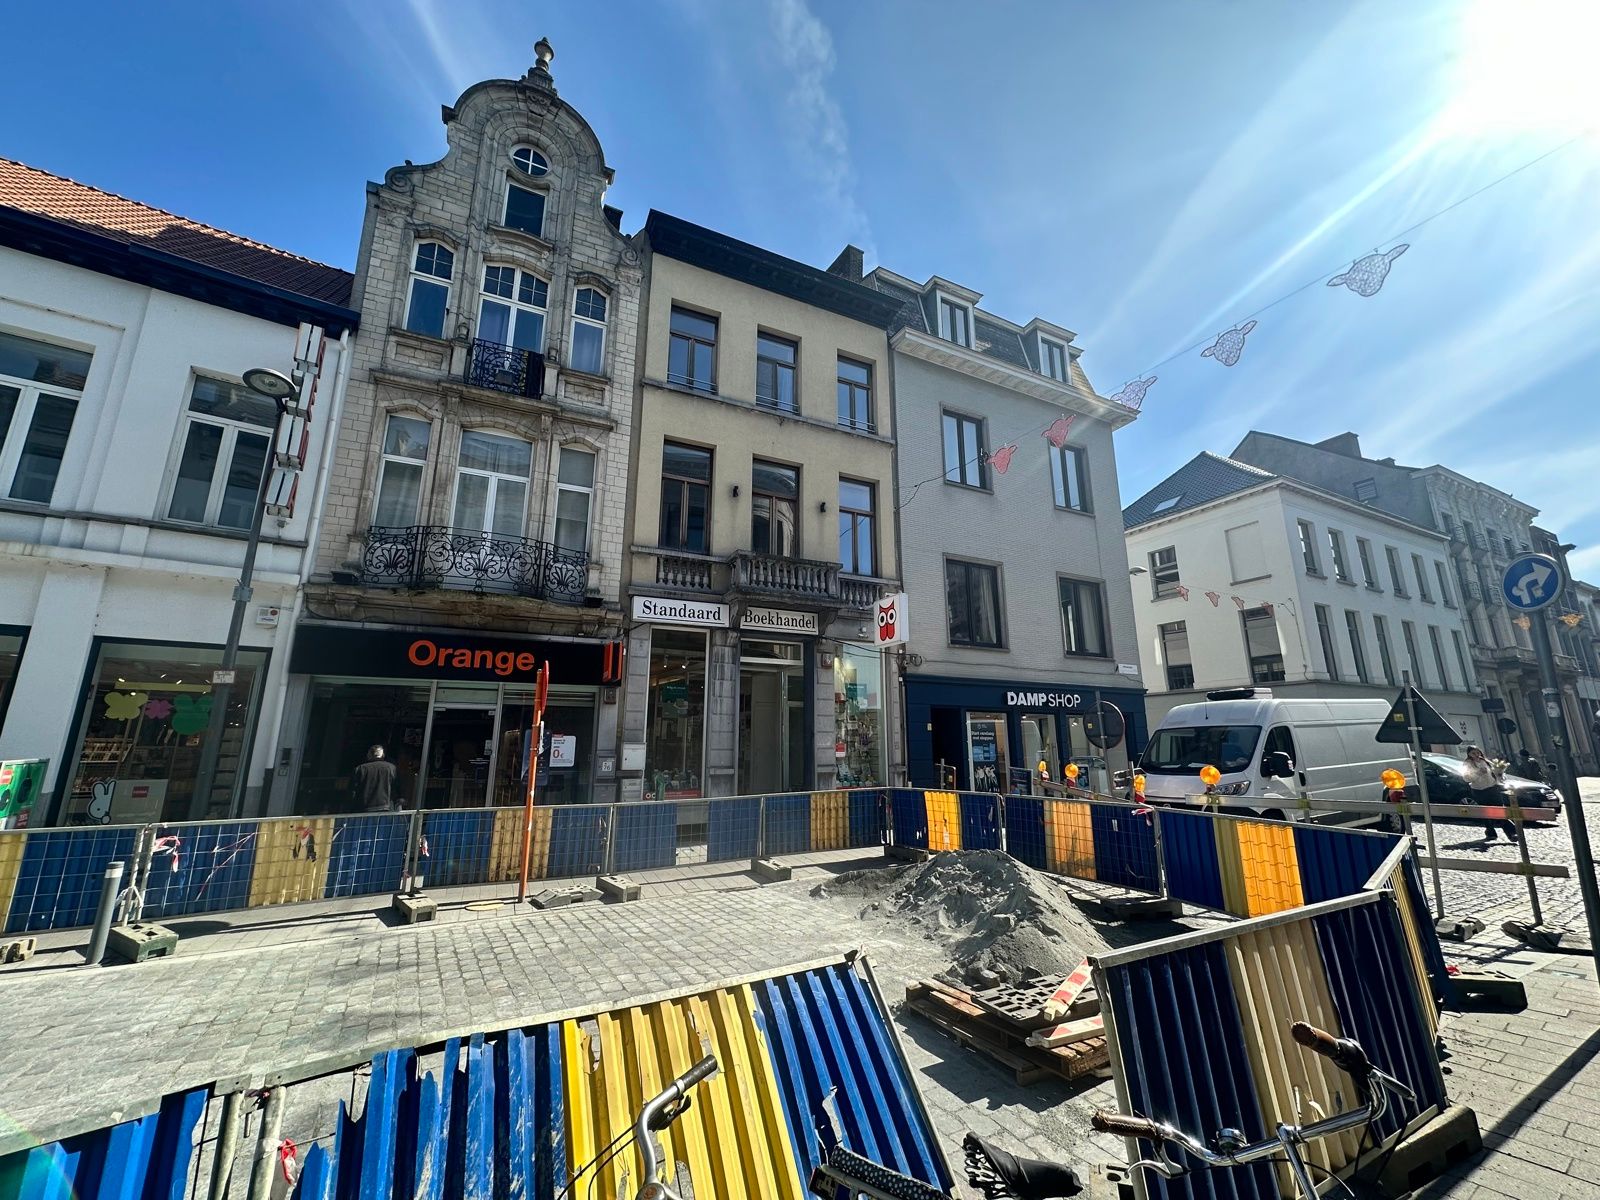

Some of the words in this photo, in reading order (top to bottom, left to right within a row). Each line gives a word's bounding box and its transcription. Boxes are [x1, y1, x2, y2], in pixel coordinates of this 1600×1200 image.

[642, 600, 721, 621] Standaard
[743, 610, 816, 629] Boekhandel
[408, 640, 535, 675] Orange
